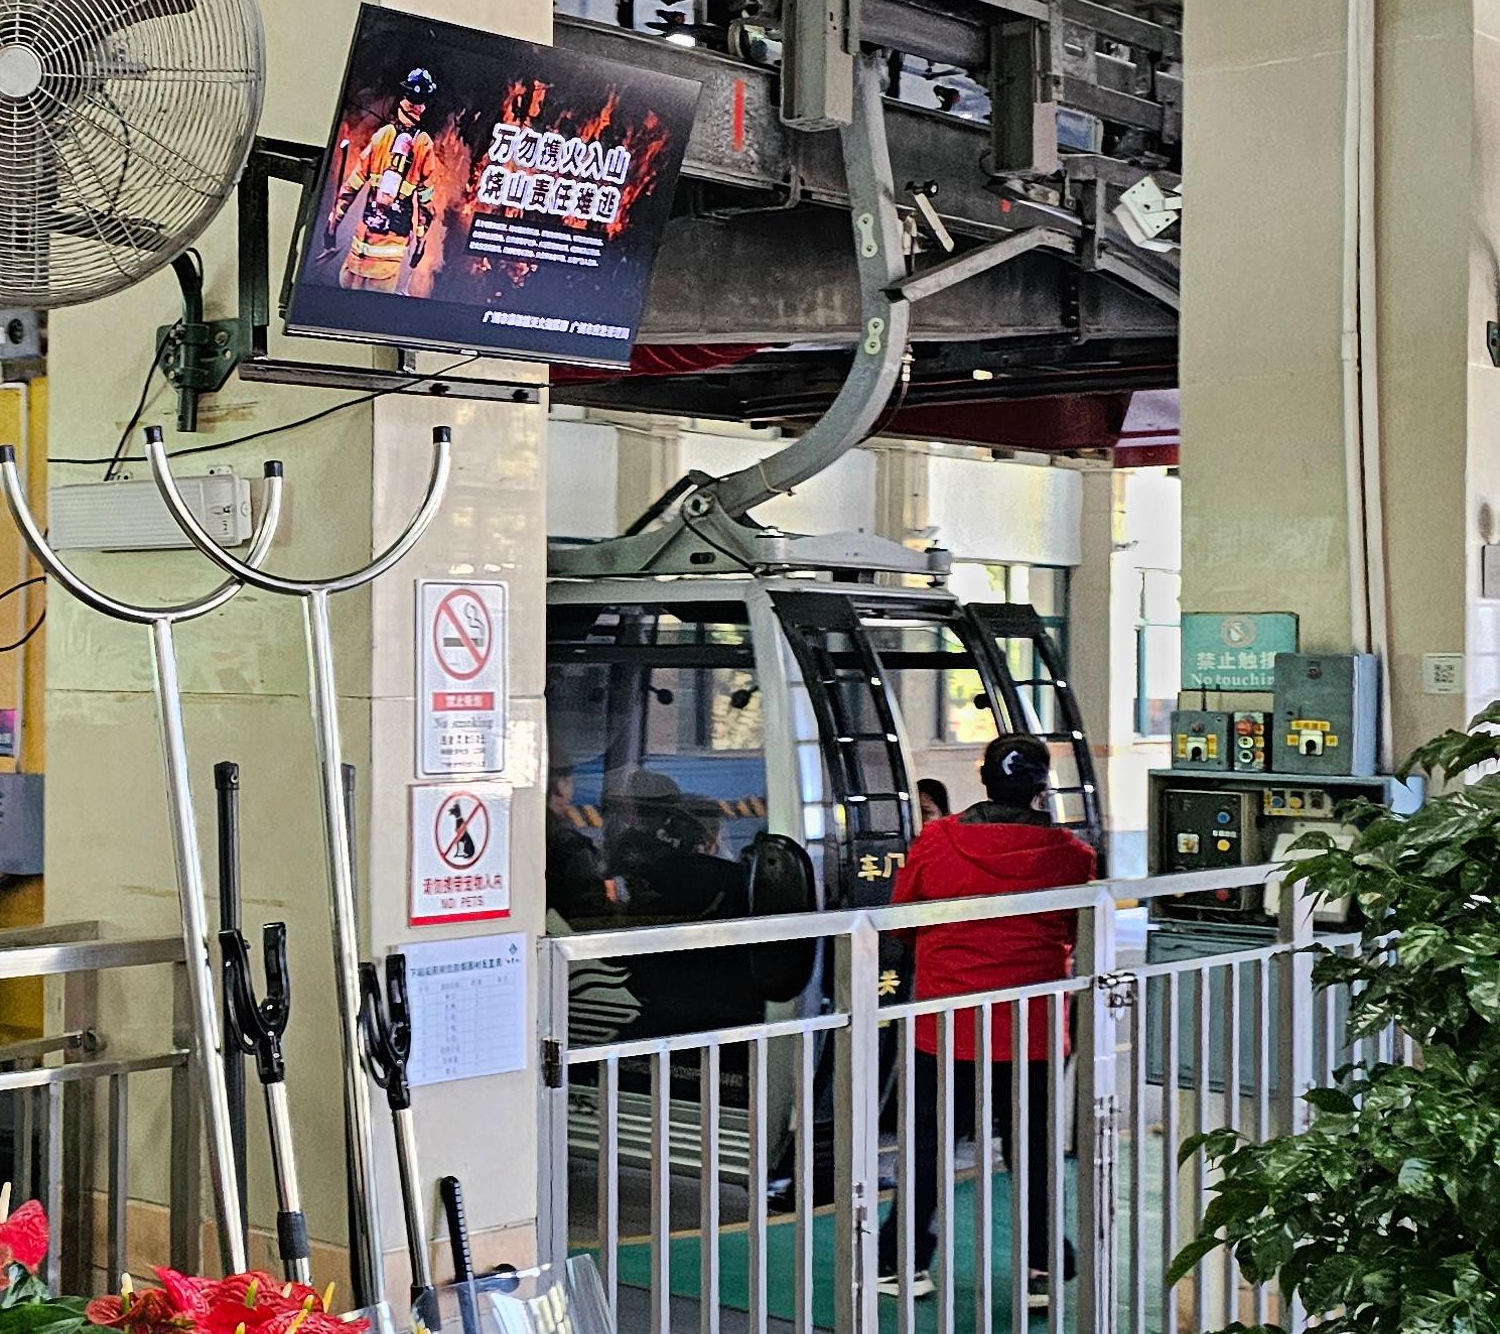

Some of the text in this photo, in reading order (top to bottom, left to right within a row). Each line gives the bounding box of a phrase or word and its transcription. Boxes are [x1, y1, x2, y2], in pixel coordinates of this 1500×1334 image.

[488, 122, 632, 185] 万勿携火入山
[1191, 673, 1275, 686] No touchin
[460, 895, 485, 908] PETS
